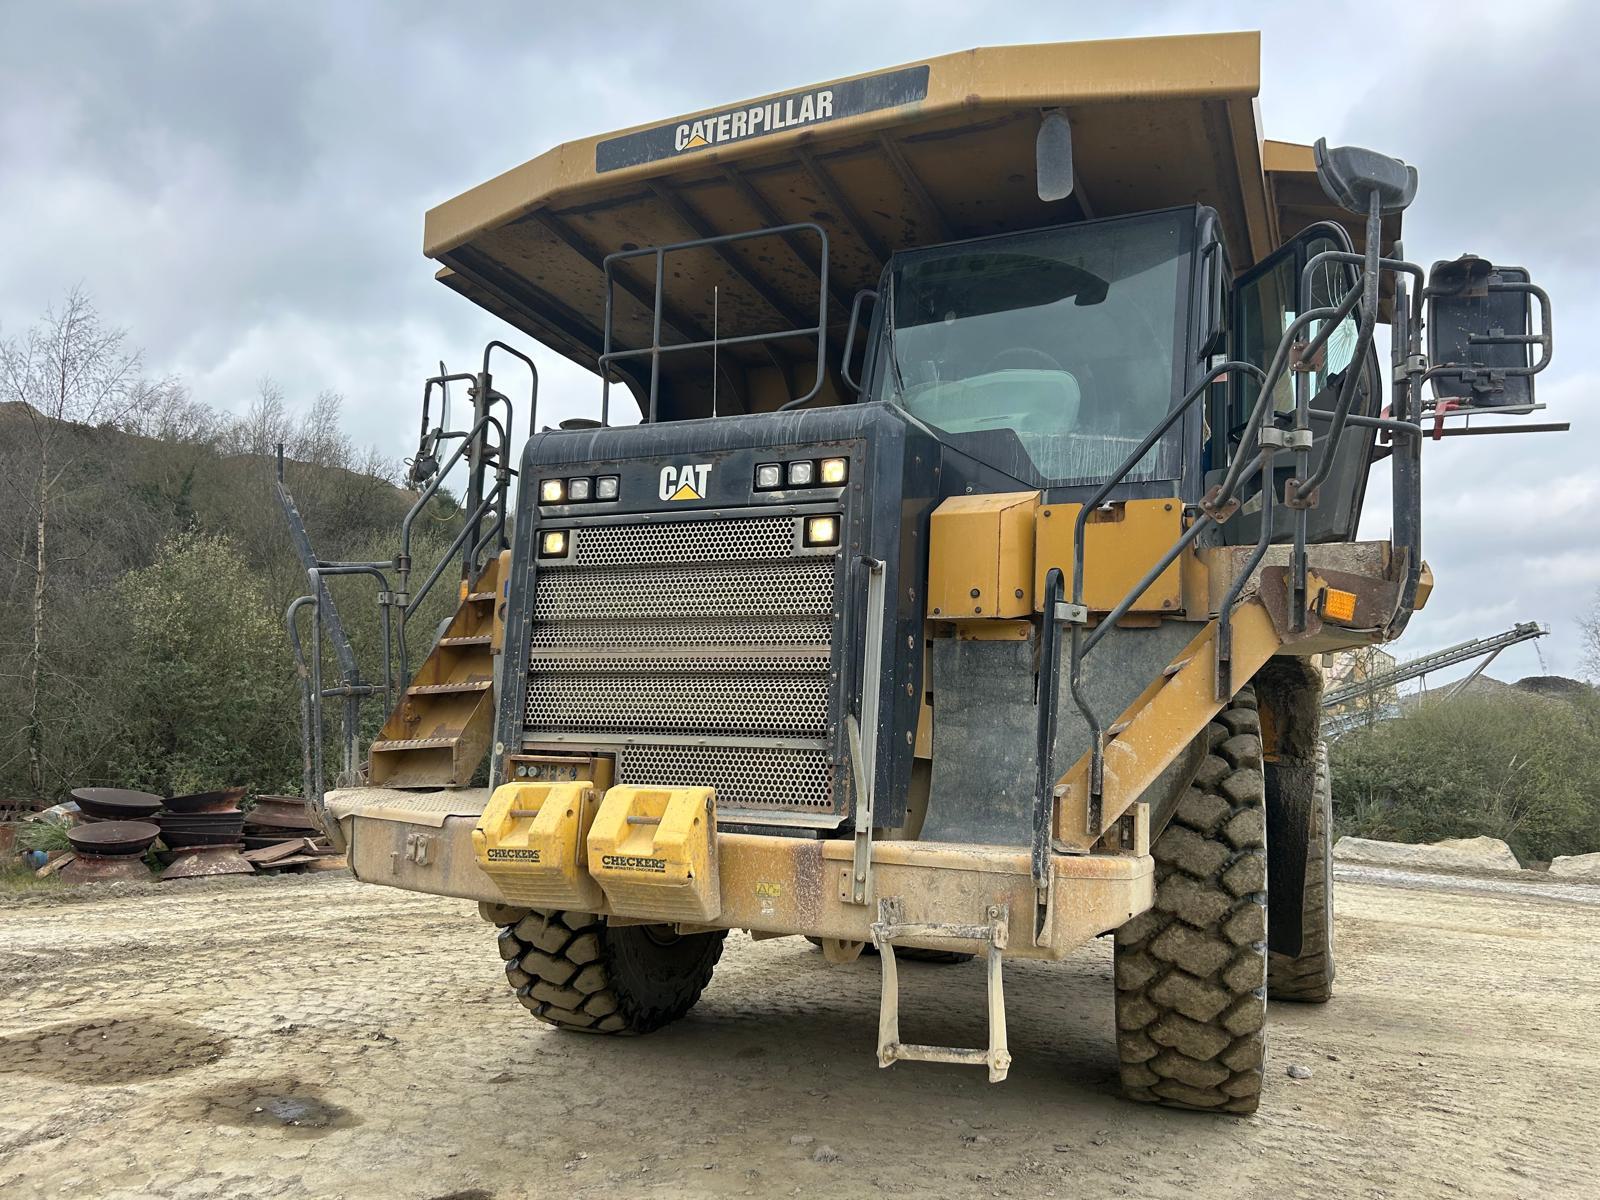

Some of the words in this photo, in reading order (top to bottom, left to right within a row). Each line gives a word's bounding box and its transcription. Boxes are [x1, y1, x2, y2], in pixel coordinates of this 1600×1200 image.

[675, 90, 833, 151] CATERPILLAR
[659, 464, 712, 501] CAT
[487, 849, 541, 859] CHECKERS
[602, 855, 666, 869] CHECKERS
